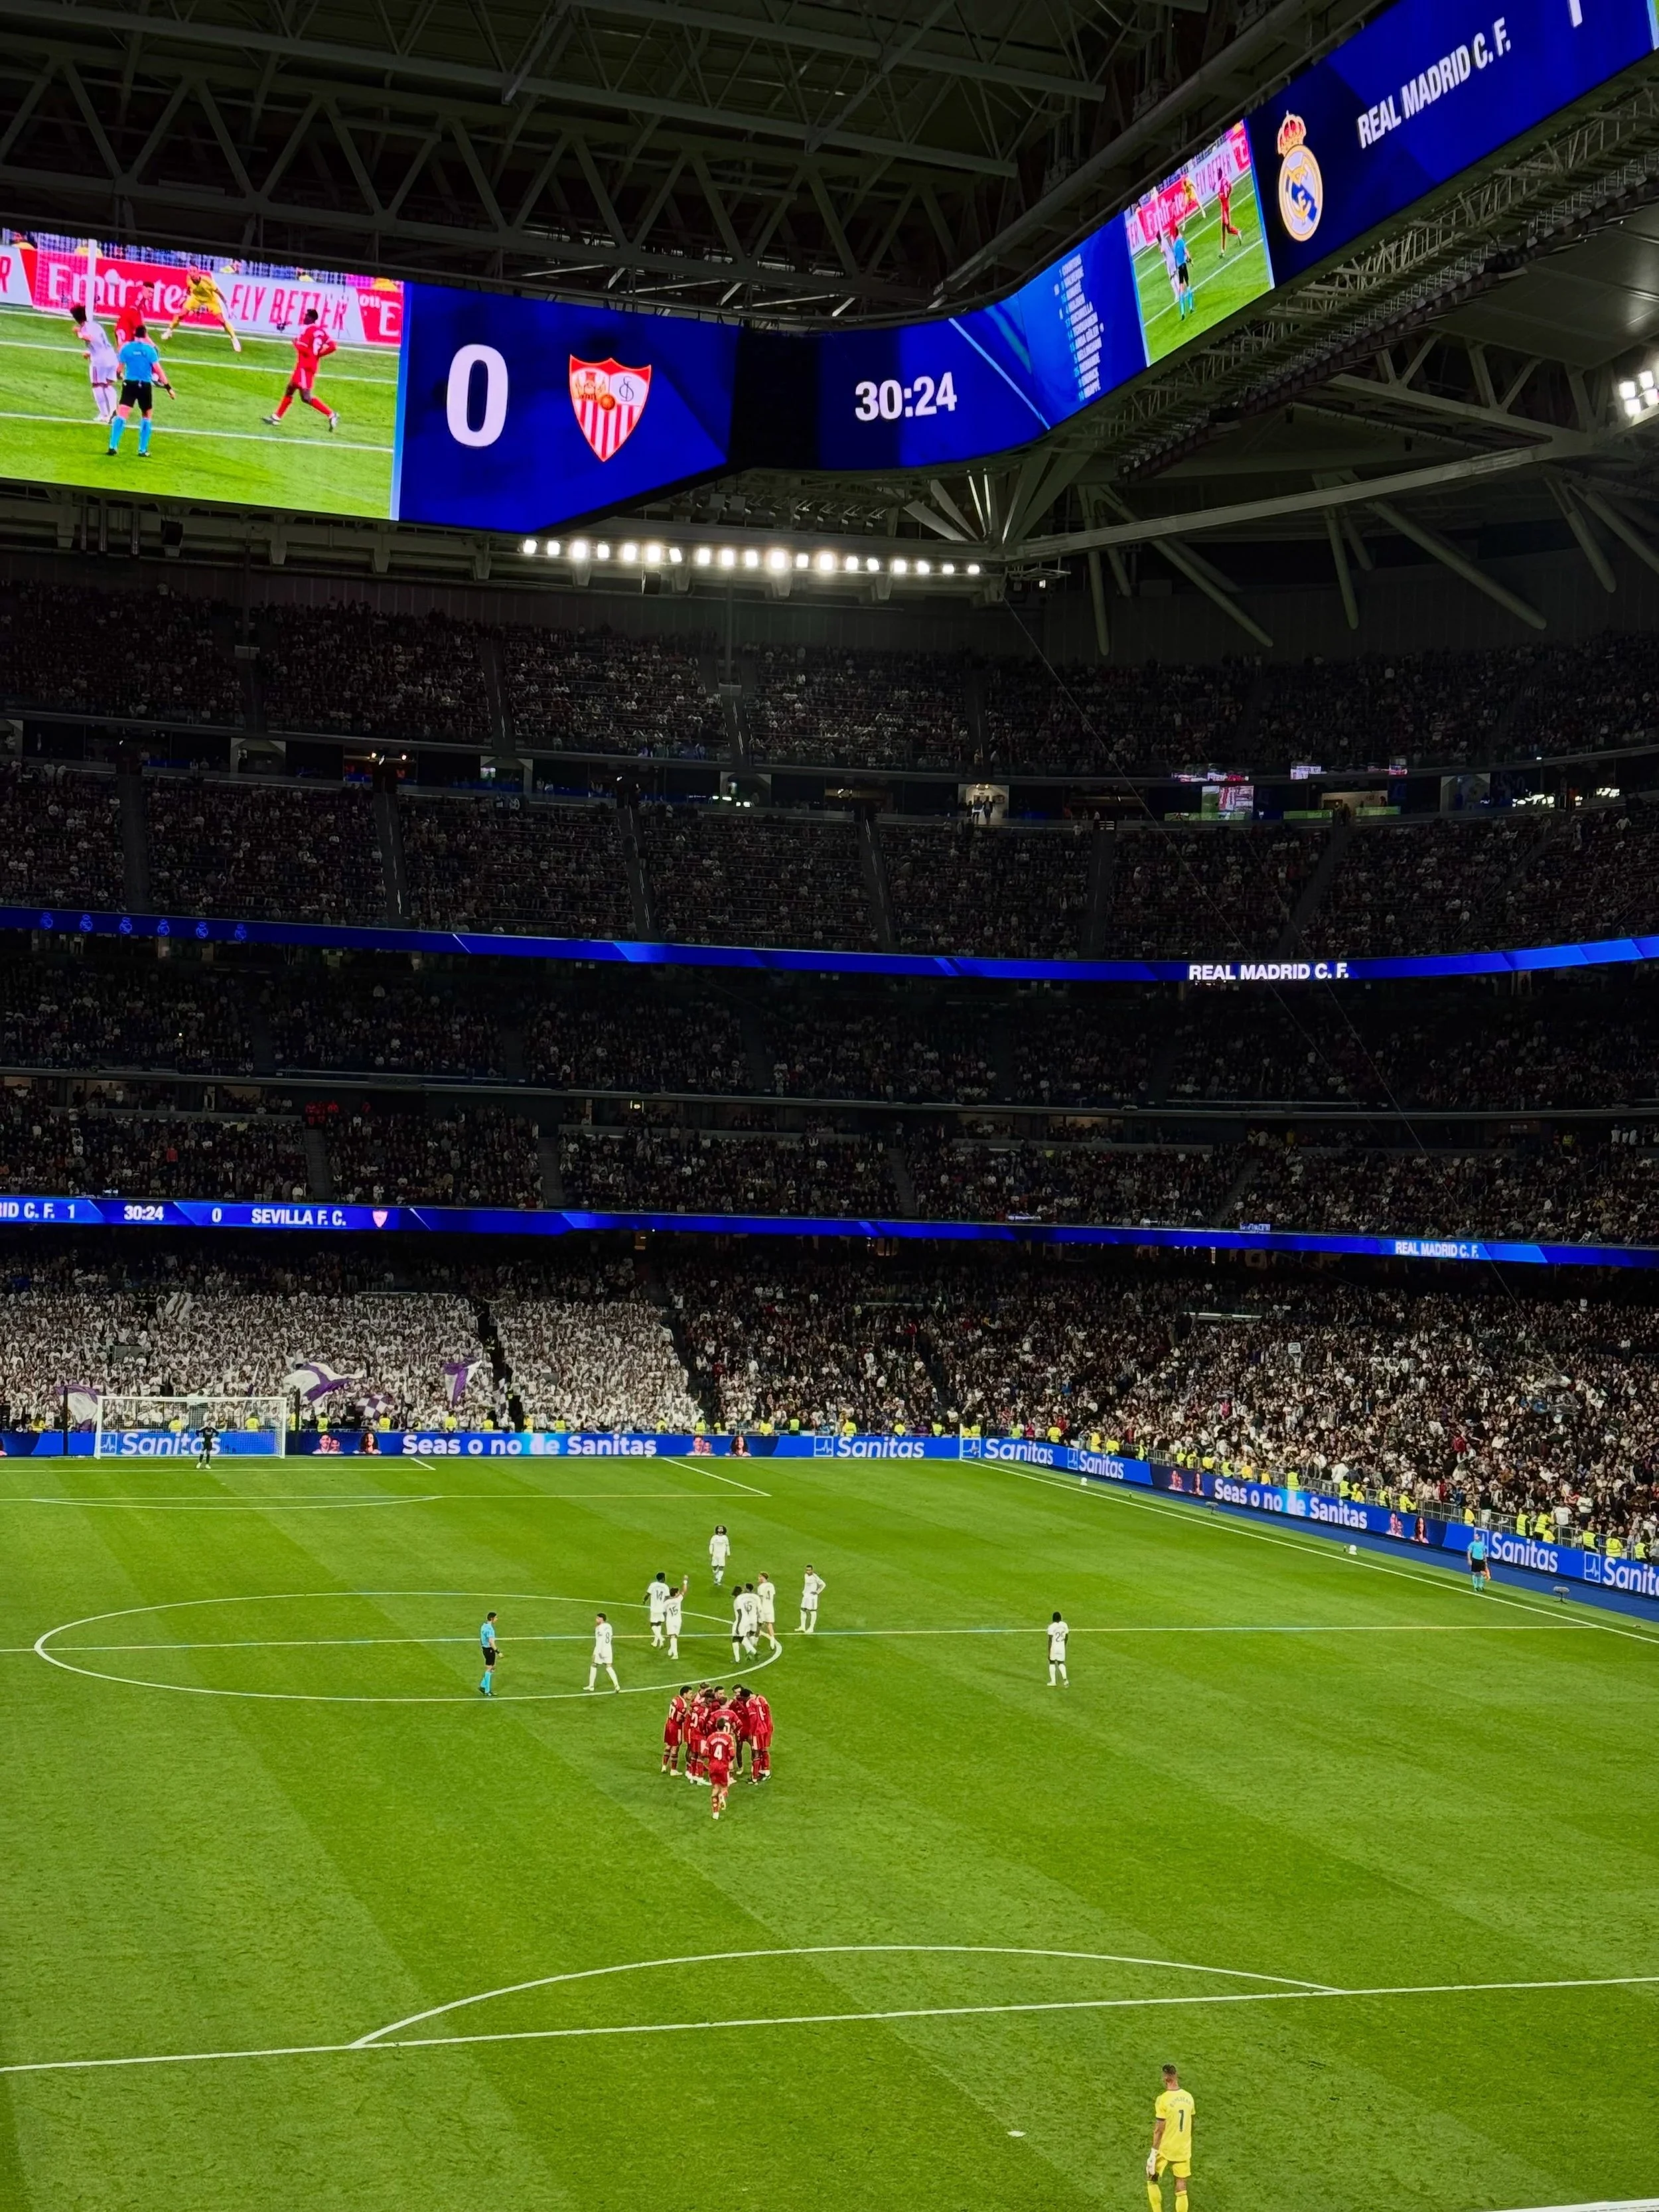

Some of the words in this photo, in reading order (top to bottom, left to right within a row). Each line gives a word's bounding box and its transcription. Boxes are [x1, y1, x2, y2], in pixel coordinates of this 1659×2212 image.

[1358, 95, 1402, 149] REAL
[1402, 44, 1471, 119] MADRID
[1473, 32, 1493, 69] C.
[1493, 17, 1511, 56] F.
[230, 284, 267, 321] FLY
[269, 289, 348, 331] BETTER
[447, 344, 508, 448] 0
[855, 372, 958, 421] 30:24
[1189, 964, 1236, 980] REAL
[1240, 964, 1311, 980] MADRID
[1315, 963, 1332, 979] C.
[1336, 962, 1349, 978] F.
[24, 1203, 39, 1218] C.
[43, 1203, 54, 1219] F.
[67, 1204, 75, 1219] 1
[123, 1205, 165, 1220] 30:24
[212, 1208, 222, 1222] 0
[251, 1209, 313, 1224] SEVILLA
[317, 1210, 328, 1225] F.
[332, 1210, 346, 1226] C.
[1396, 1241, 1419, 1254] REAL
[1421, 1242, 1457, 1257] MADRID
[1459, 1244, 1469, 1257] C.
[1471, 1245, 1479, 1258] F.
[402, 1436, 461, 1455] Seas
[467, 1441, 482, 1455] o
[491, 1441, 522, 1455] no
[567, 1435, 657, 1455] Sanitas
[836, 1436, 924, 1459] Sanitas
[985, 1438, 1053, 1465] Sanitas
[1079, 1451, 1124, 1480] Sanitas
[1214, 1479, 1247, 1505] Seas
[1251, 1493, 1260, 1507] o
[1263, 1491, 1283, 1512] no
[1310, 1497, 1368, 1529] Sanitas
[1491, 1531, 1559, 1573] Sanitas
[1603, 1556, 1659, 1596] Sanit
[669, 1605, 679, 1617] 15
[605, 1631, 611, 1644] 8
[713, 1744, 723, 1761] 4
[1178, 2109, 1185, 2132] 1
